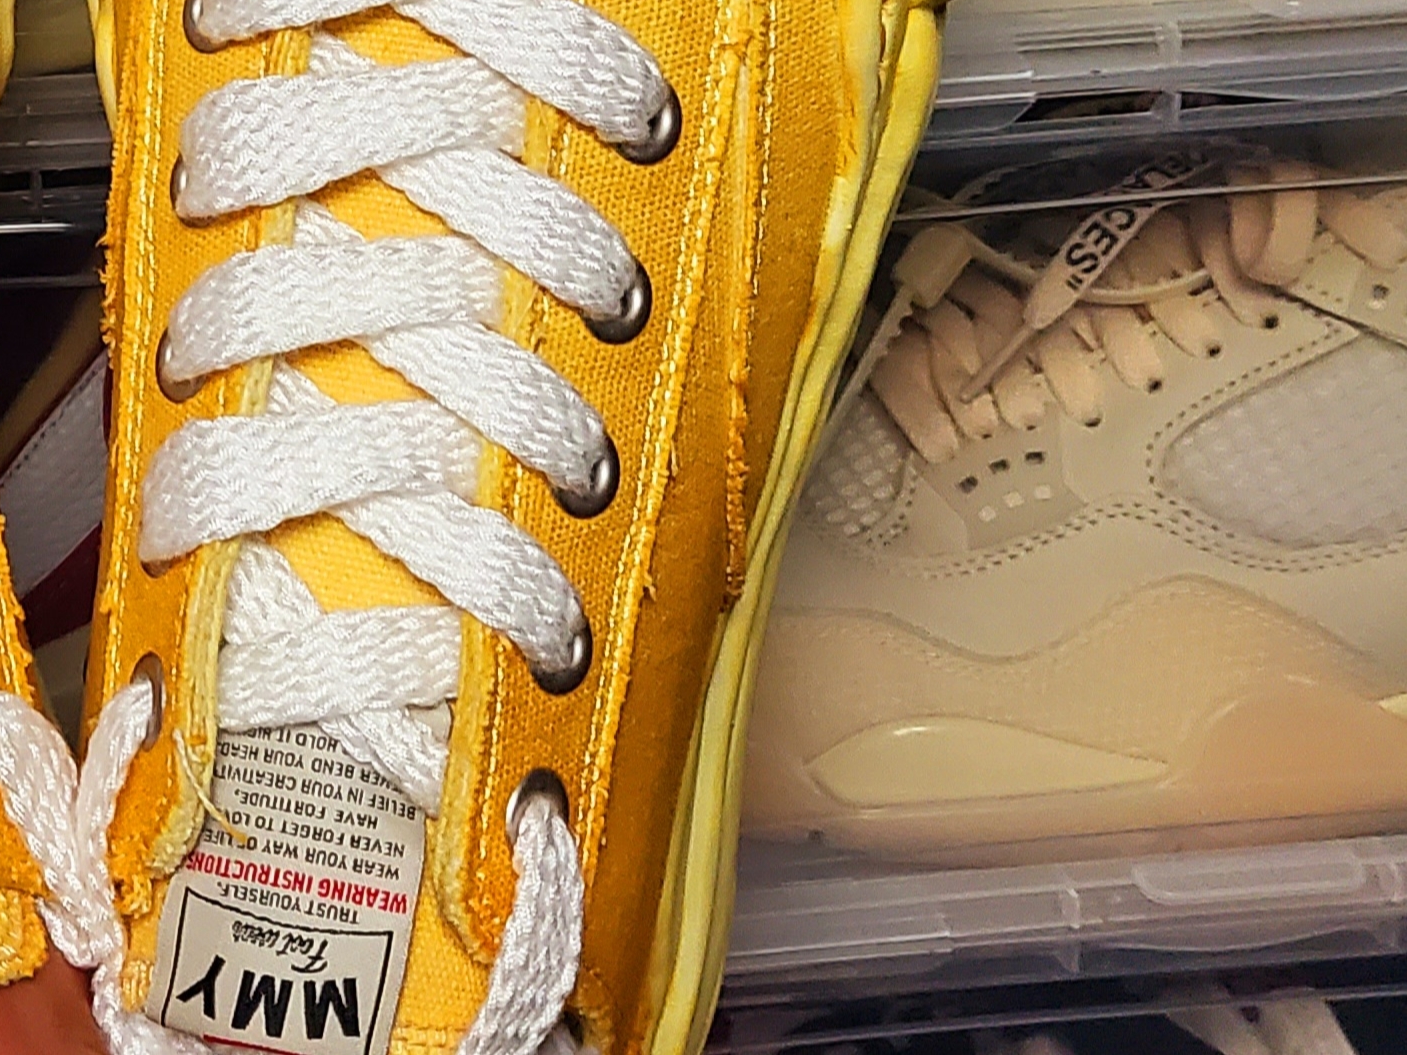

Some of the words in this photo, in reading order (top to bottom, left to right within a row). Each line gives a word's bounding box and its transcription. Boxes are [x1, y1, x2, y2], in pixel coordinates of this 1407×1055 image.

[277, 729, 290, 743] IT
[296, 733, 338, 752] HOLD
[264, 748, 304, 769] YOUR
[312, 757, 354, 779] BEND
[213, 764, 296, 791] CREATIVIT
[302, 779, 342, 801] YOUR
[347, 788, 363, 806] IN
[368, 794, 416, 820] BELIEF
[255, 815, 274, 831] TO
[334, 810, 378, 830] HAVE
[280, 819, 344, 846] FORGET
[262, 839, 298, 860] WAY
[350, 835, 405, 858] NEVER
[305, 847, 347, 870] YOUR
[353, 858, 399, 880] WEAR
[186, 852, 313, 894] INSTRUCTIONS
[318, 878, 407, 914] WEARING
[304, 900, 359, 925] TRUST
[176, 955, 360, 1039] MMY
